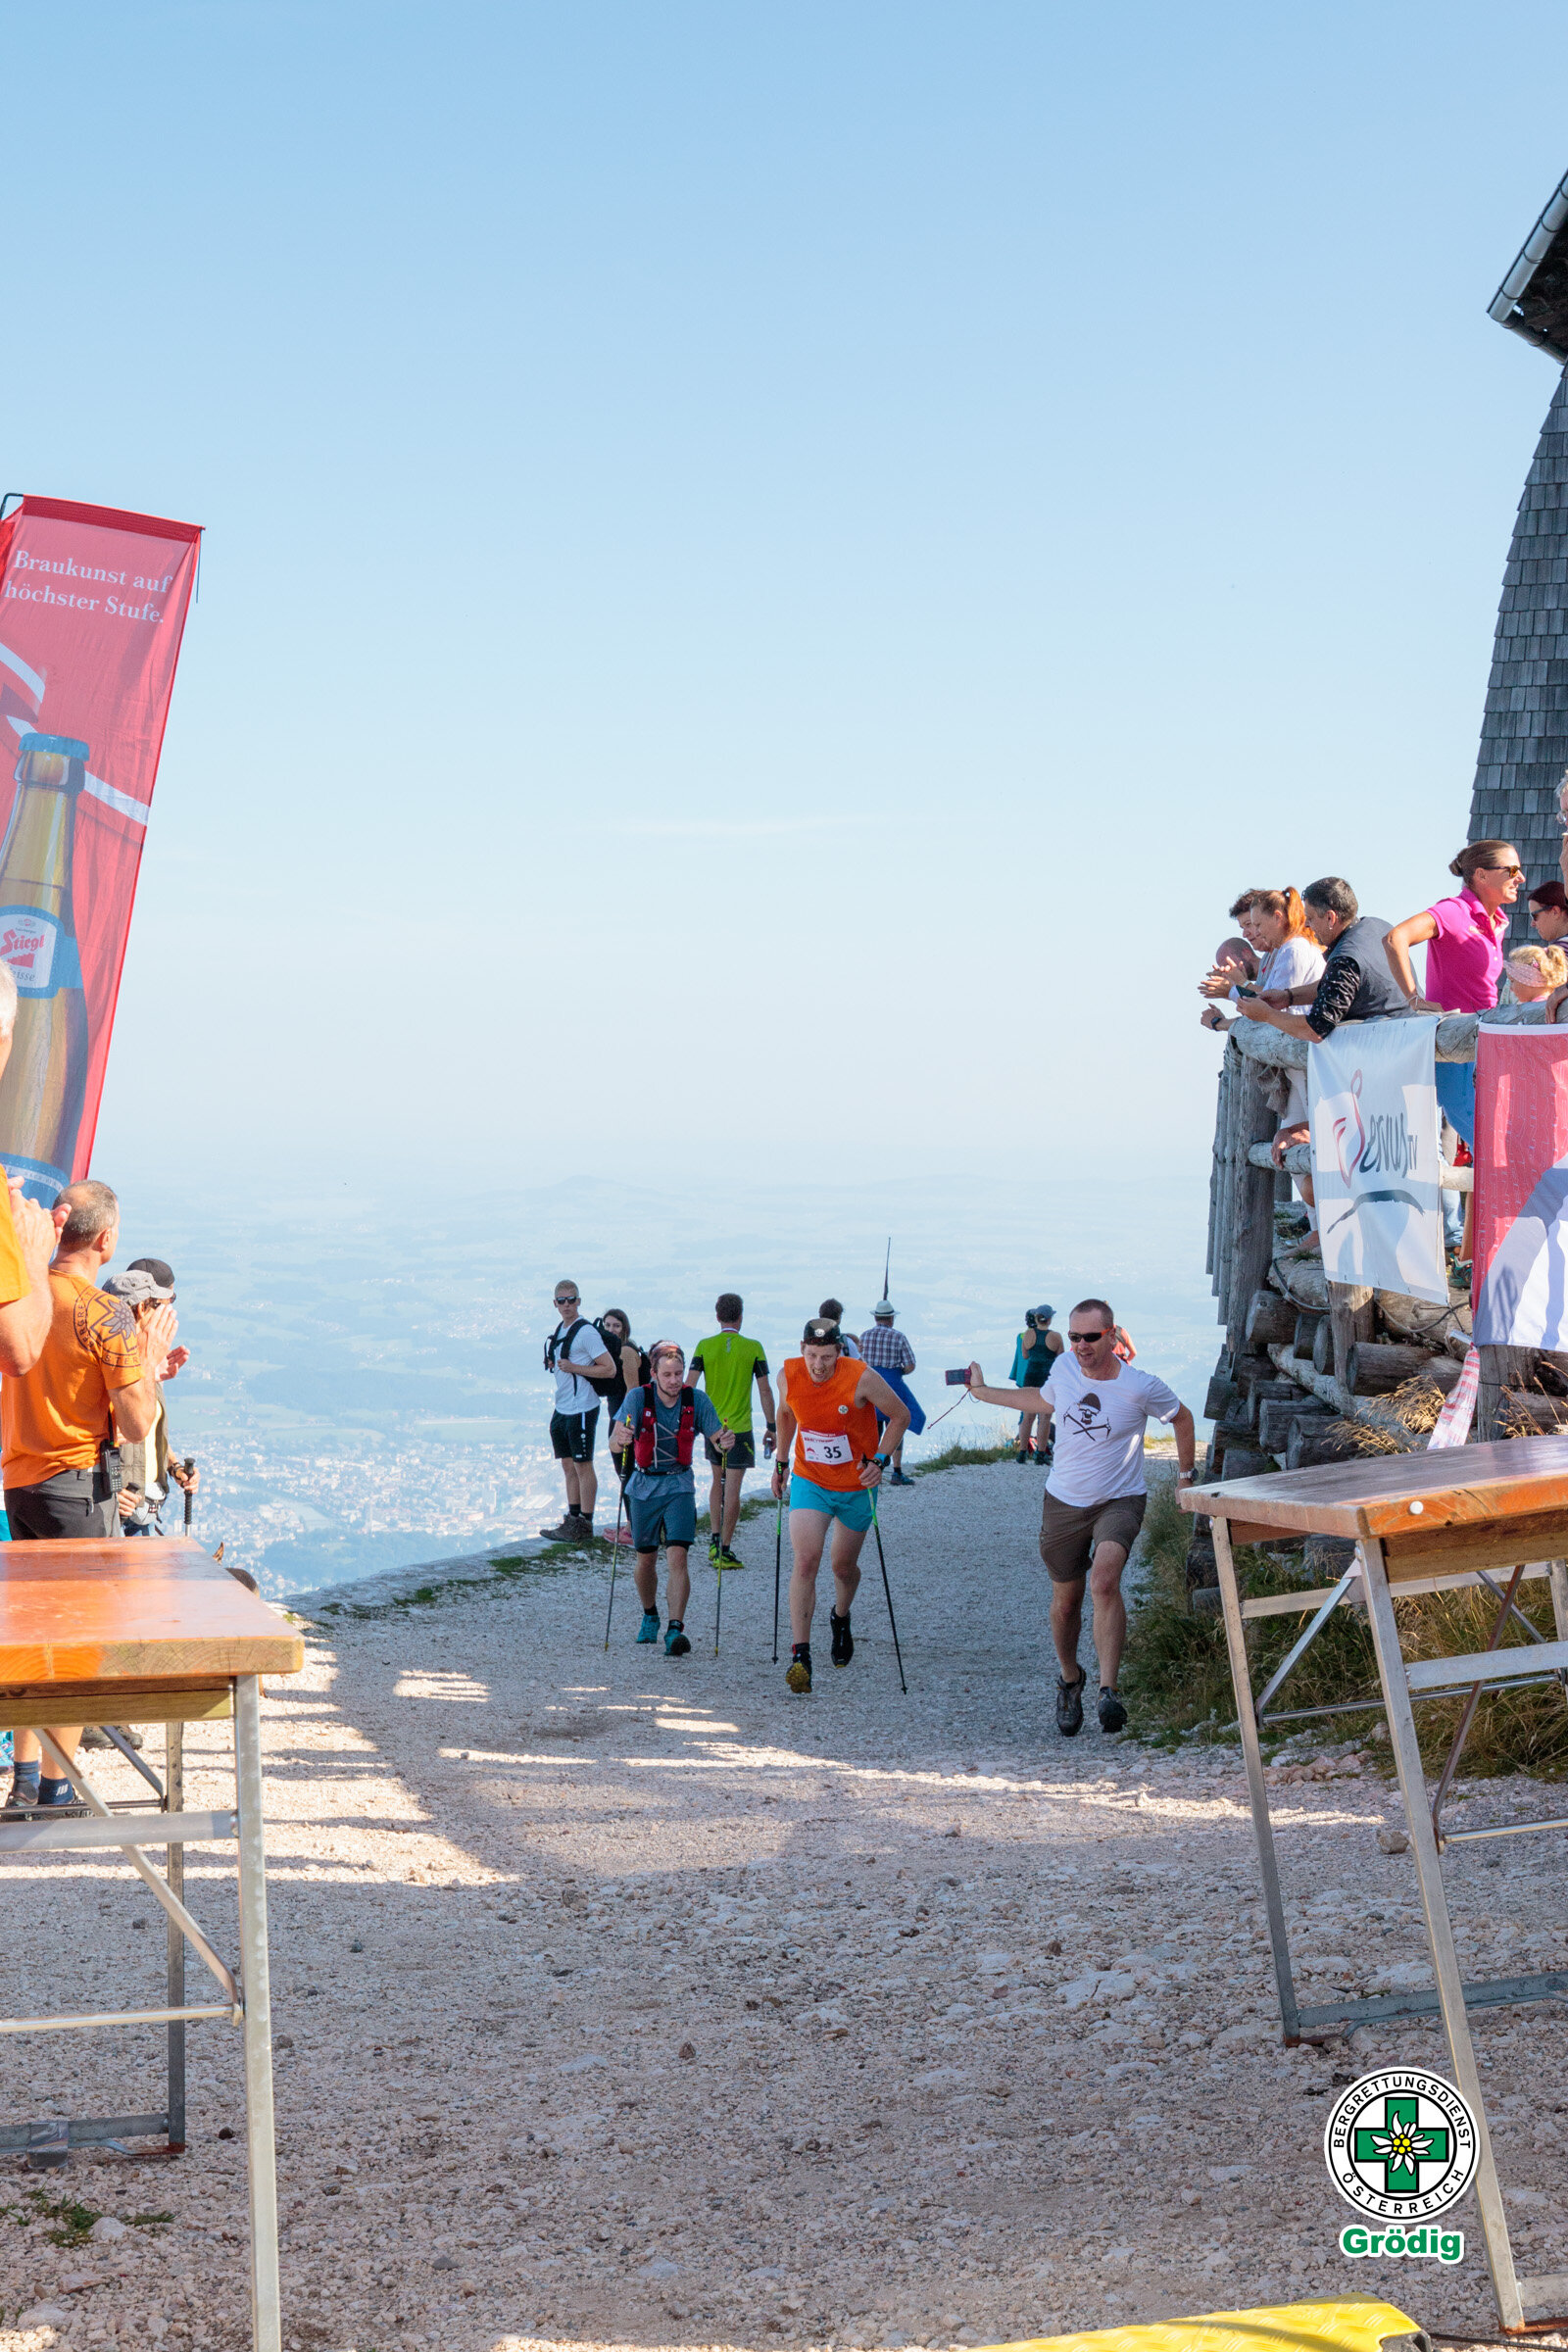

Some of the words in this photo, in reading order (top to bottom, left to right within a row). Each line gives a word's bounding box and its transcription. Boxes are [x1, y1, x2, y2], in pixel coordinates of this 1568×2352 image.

[14, 550, 126, 586] Braukunst
[132, 575, 173, 594] auf
[4, 580, 100, 612] höchster
[105, 596, 165, 623] Stufe.
[0, 929, 45, 956] Stiegl
[823, 1446, 843, 1459] 35
